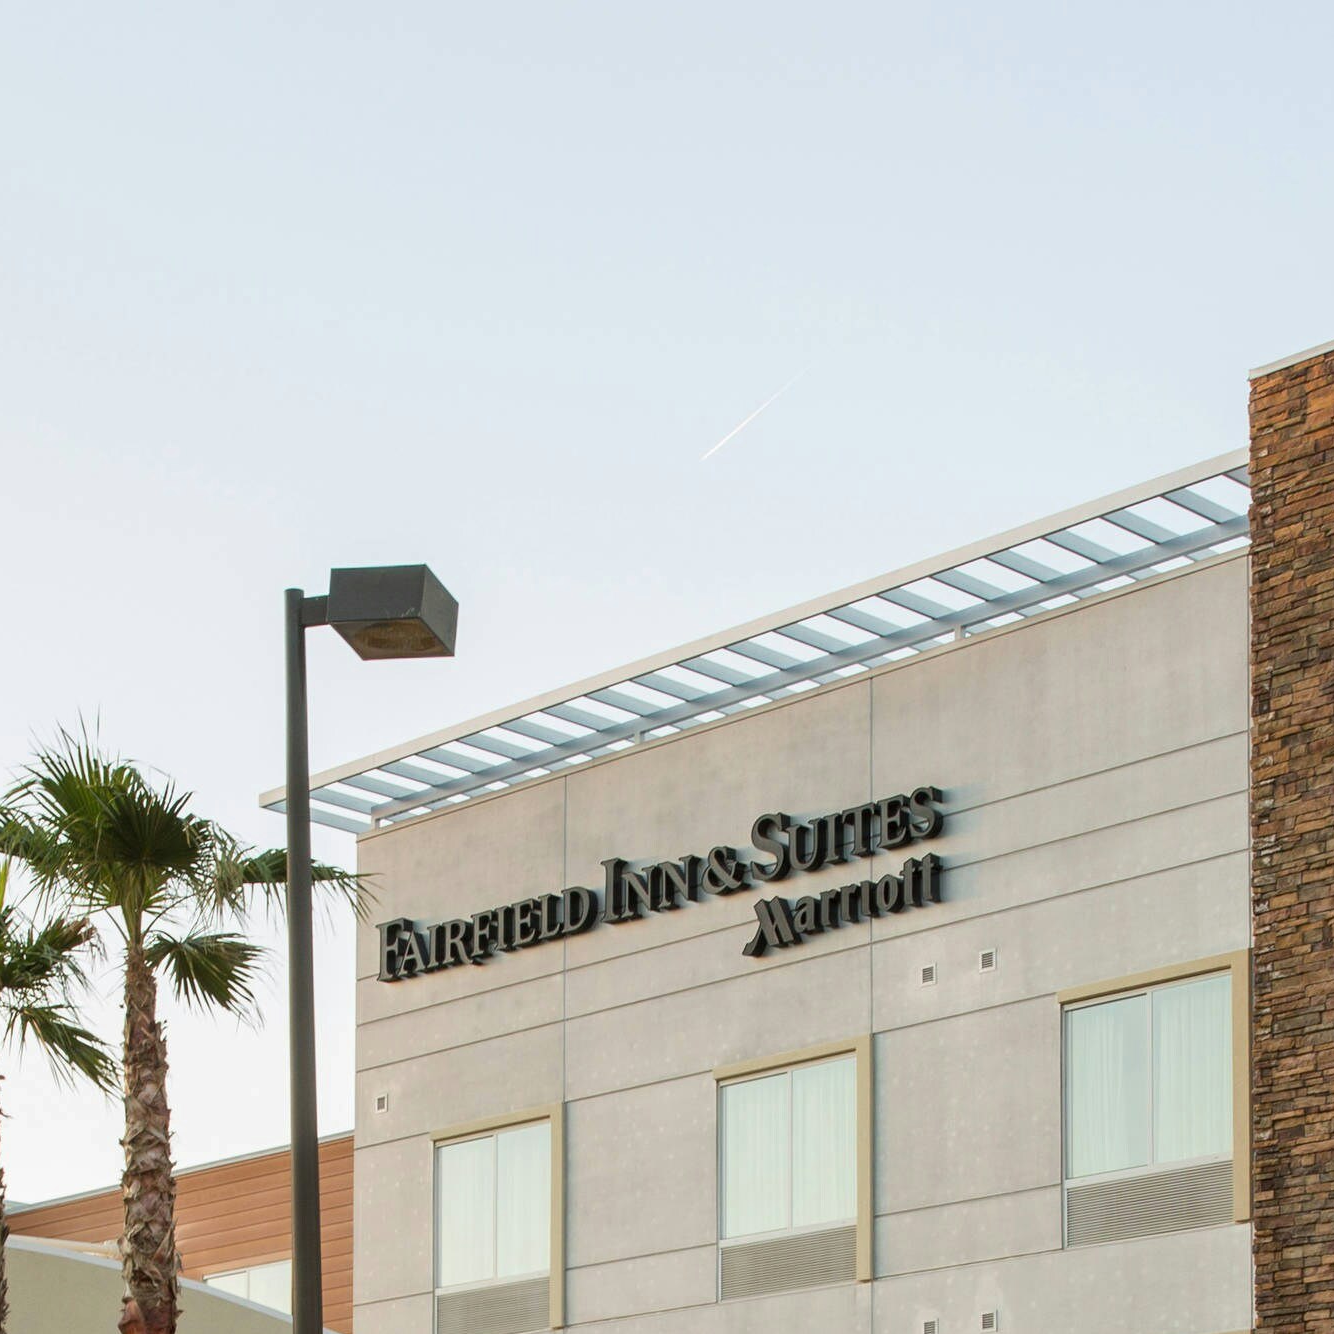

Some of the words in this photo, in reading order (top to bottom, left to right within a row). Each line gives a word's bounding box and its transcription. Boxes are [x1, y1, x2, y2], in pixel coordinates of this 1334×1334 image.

[376, 886, 599, 982] FAIRFIELD
[750, 786, 944, 882] SUITES
[742, 852, 944, 957] Marriott
